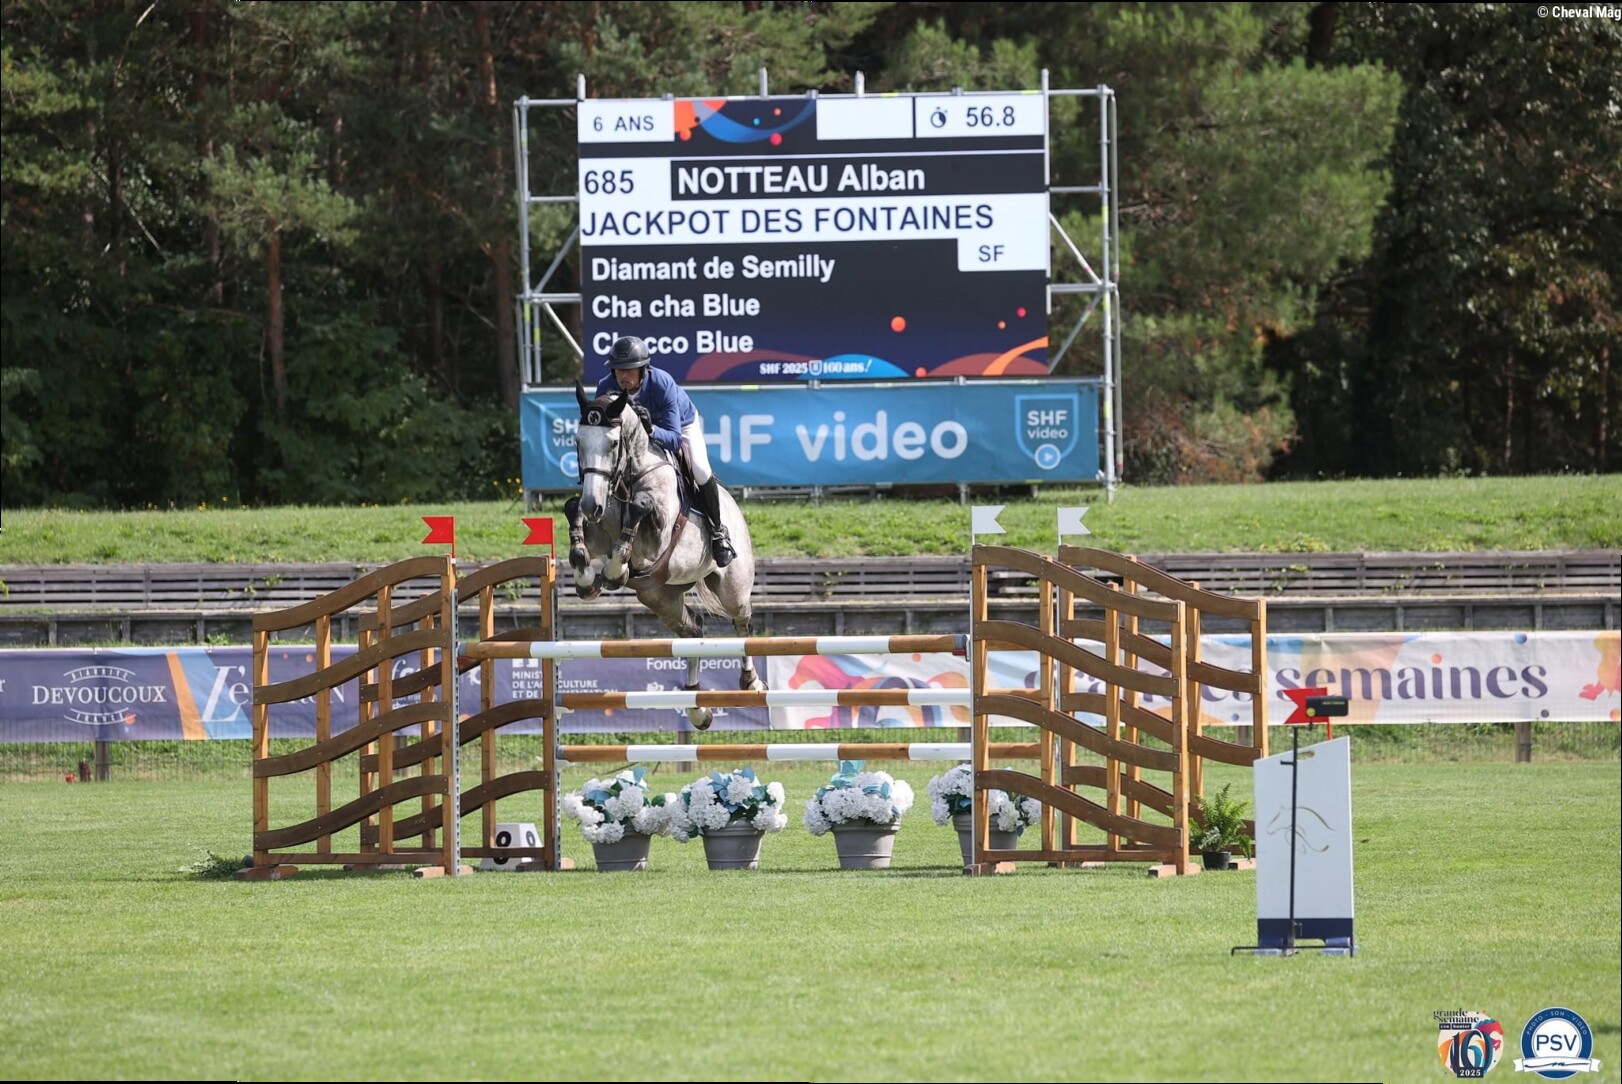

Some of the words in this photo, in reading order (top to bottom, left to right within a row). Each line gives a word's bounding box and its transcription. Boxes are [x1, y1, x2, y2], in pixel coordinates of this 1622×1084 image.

[593, 116, 603, 132] 6
[614, 115, 655, 132] ANS
[966, 105, 1016, 127] 56.8
[584, 170, 634, 195] 685
[678, 165, 829, 195] NOTTEAU
[837, 163, 926, 192] Alban
[581, 210, 730, 237] JACKPOT
[742, 208, 803, 234] DES
[814, 204, 994, 233] FONTAINES
[978, 244, 1005, 262] SF
[591, 256, 697, 281] Diamant
[703, 255, 735, 280] de
[741, 254, 836, 283] Semilly
[591, 295, 642, 319] Cha
[649, 294, 696, 318] cha
[703, 293, 761, 317] Blue
[592, 331, 690, 355] Ccco
[696, 330, 754, 354] Blue
[759, 362, 781, 375] SHF
[782, 361, 808, 375] 2025
[552, 417, 579, 435] SH
[1026, 409, 1069, 427] SHF
[698, 414, 775, 464] HF
[795, 409, 969, 462] video
[1026, 426, 1069, 440] video
[646, 657, 688, 671] Fonds
[512, 680, 525, 689] DE
[1275, 663, 1549, 703] semaines
[31, 684, 167, 705] DEVOUCOUX
[512, 690, 524, 699] ET
[526, 690, 539, 699] DE
